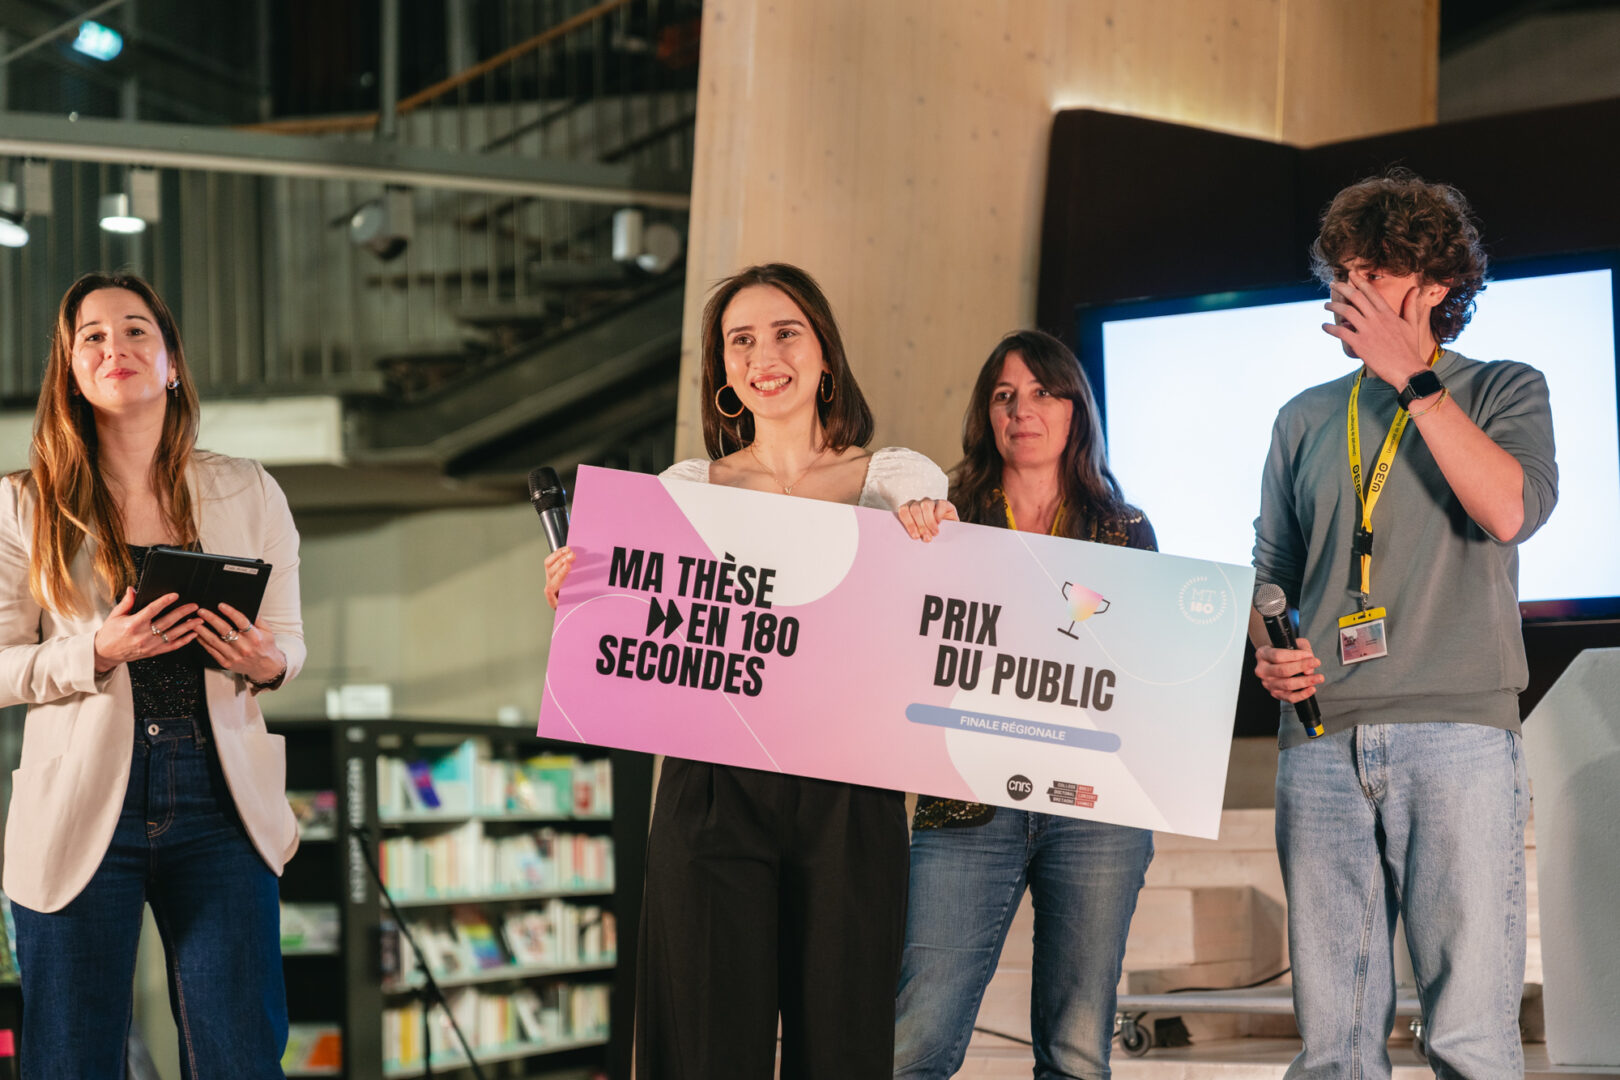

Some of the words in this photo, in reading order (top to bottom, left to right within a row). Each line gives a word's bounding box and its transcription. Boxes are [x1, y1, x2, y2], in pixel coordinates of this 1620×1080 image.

[1371, 463, 1388, 492] UBO
[607, 546, 665, 593] MA
[677, 552, 777, 610] THÈSE
[686, 602, 731, 648] EN
[741, 610, 800, 658] 180
[919, 594, 1002, 647] PRIX
[595, 634, 766, 697] SECONDES
[934, 645, 983, 691] DU
[991, 653, 1117, 712] PUBLIC
[960, 716, 1000, 731] FINALE
[1001, 721, 1066, 741] RÉGIONALE
[1008, 780, 1031, 793] cnrs
